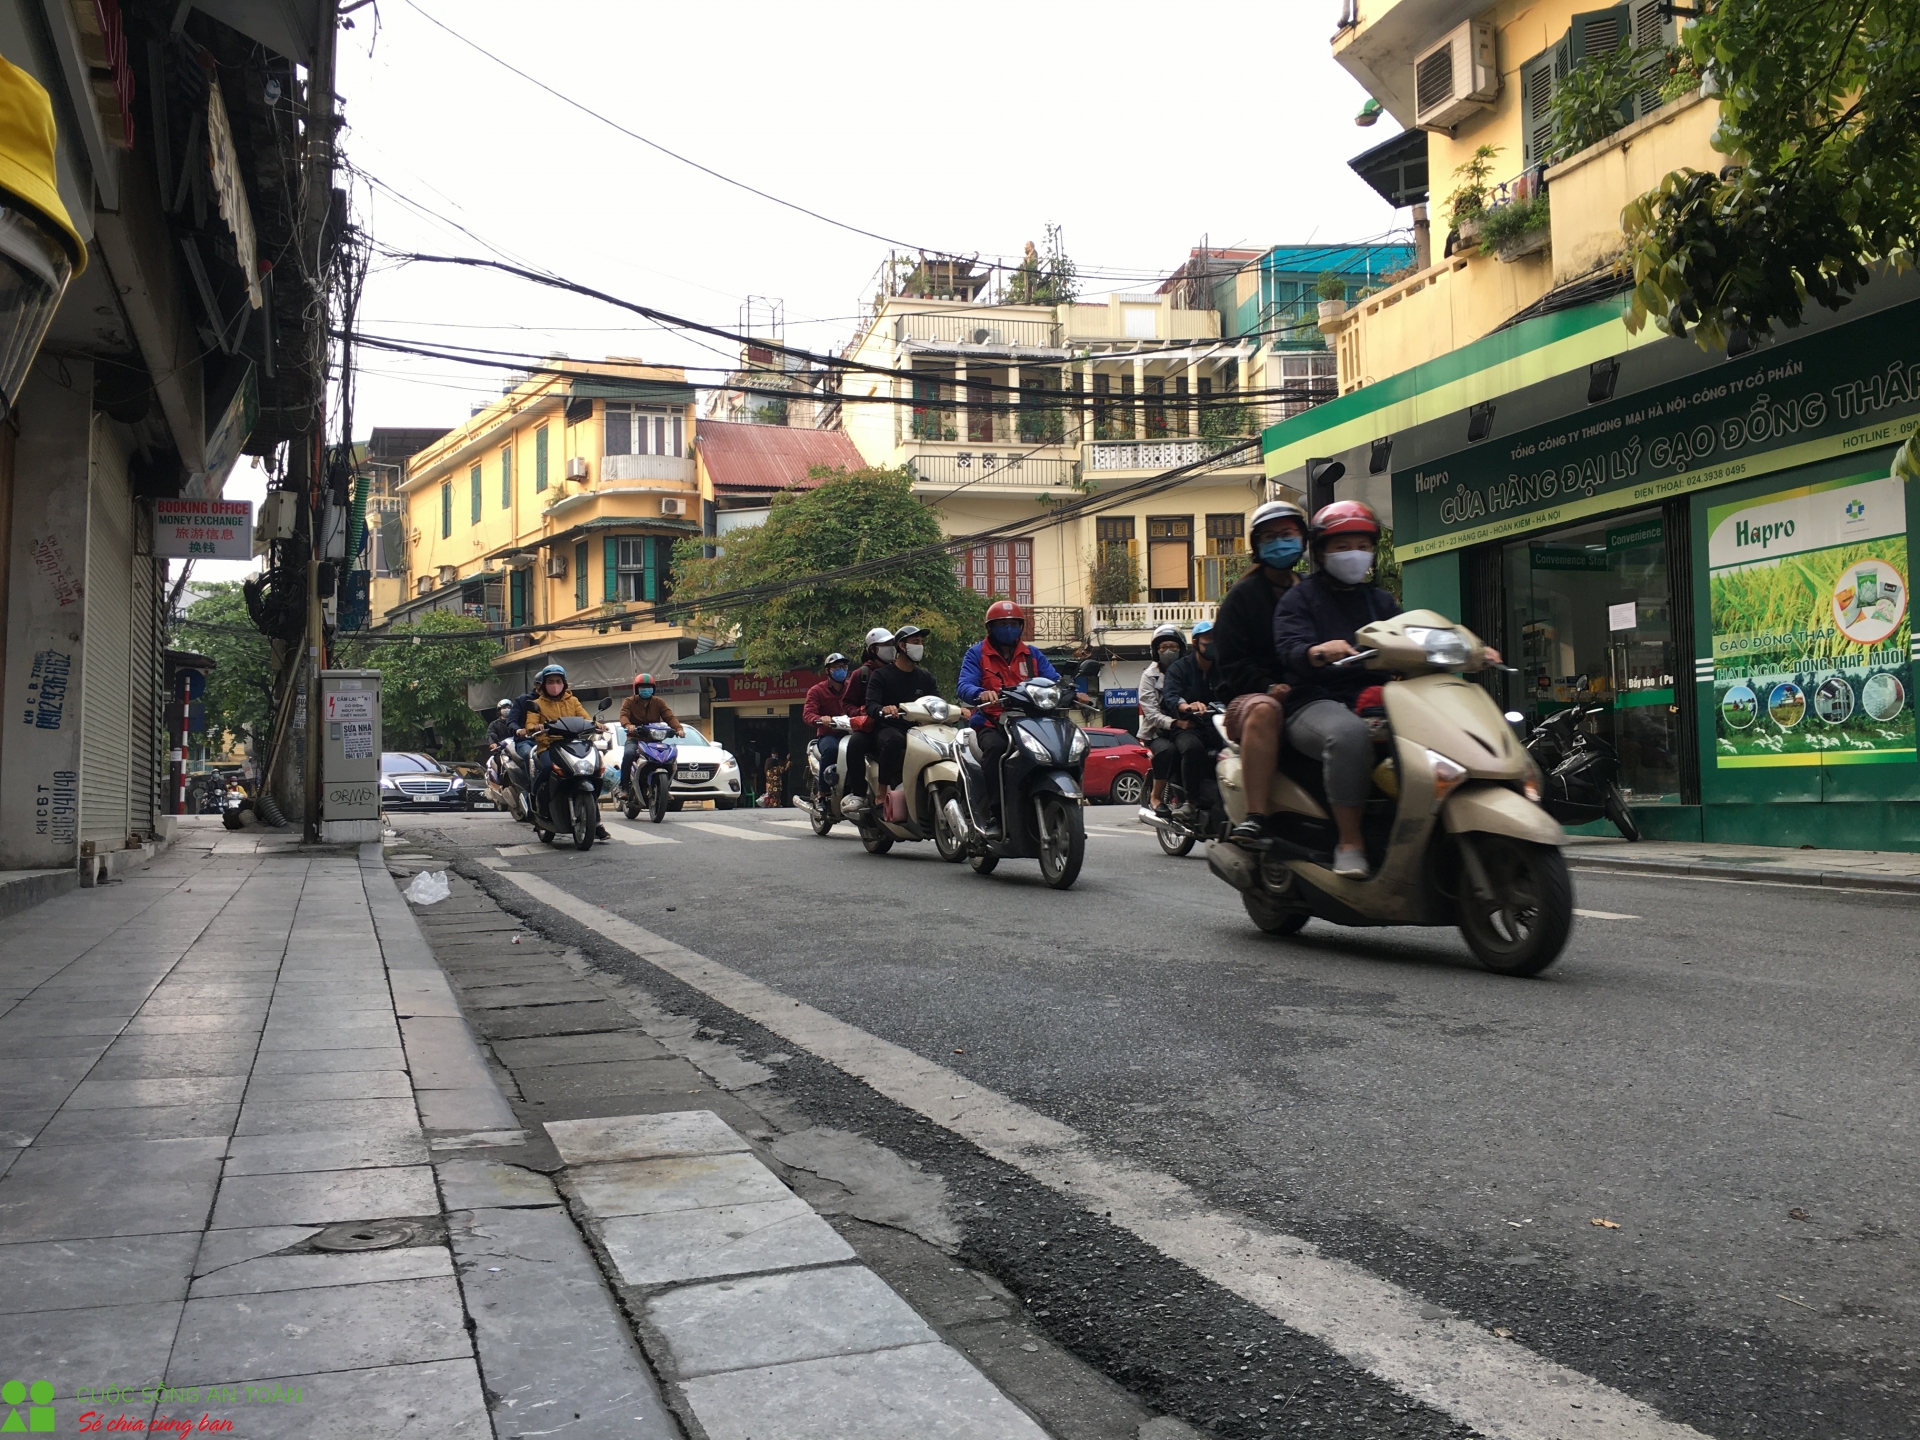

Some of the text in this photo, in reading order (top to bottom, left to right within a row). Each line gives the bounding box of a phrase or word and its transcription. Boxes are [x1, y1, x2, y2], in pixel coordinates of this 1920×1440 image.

[1511, 442, 1536, 460] TỔNG
[1538, 434, 1567, 452] CÔNG
[1568, 431, 1579, 444] TY
[1582, 417, 1622, 439] THƯƠNG
[1625, 410, 1645, 426] MẠI
[1648, 402, 1664, 419] HÀ
[1666, 394, 1687, 414] NỘI
[1692, 384, 1727, 405] CÔNG
[1729, 380, 1744, 395] TY
[1745, 366, 1765, 388] CỔ
[1767, 359, 1803, 383] PHẦN
[1842, 427, 1891, 449] HOTLINE
[1440, 483, 1485, 525] CỬA
[1489, 469, 1558, 513] HÀNG
[1561, 455, 1608, 497] ĐẠI
[1611, 435, 1643, 481] LÝ
[1649, 425, 1716, 473] GẠO
[1721, 393, 1828, 451] ĐỒNG
[1415, 471, 1449, 494] Hapro
[1634, 464, 1746, 499] ĐIỆN THOẠI: 024.3938 0495
[157, 500, 249, 515] BOOKING OFFICE
[159, 515, 243, 526] MONEY EXCHANGE
[1438, 539, 1445, 549] 21
[1450, 536, 1457, 546] 23
[1477, 529, 1489, 540] GAI
[1494, 523, 1513, 534] HOÀN
[1536, 513, 1547, 524] HÀ
[1548, 509, 1561, 521] NỘI
[175, 527, 235, 540] 旅游信息
[1611, 527, 1662, 547] Convenience
[1736, 519, 1795, 549] Hapro
[188, 541, 215, 554] 换钱
[1535, 553, 1586, 566] Convenience
[1798, 626, 1836, 642] THÁP
[734, 675, 798, 692] Hồng Tích
[1628, 675, 1641, 689] Đẩy
[1642, 676, 1655, 687] vào
[343, 722, 372, 733] SỬA NHÀ
